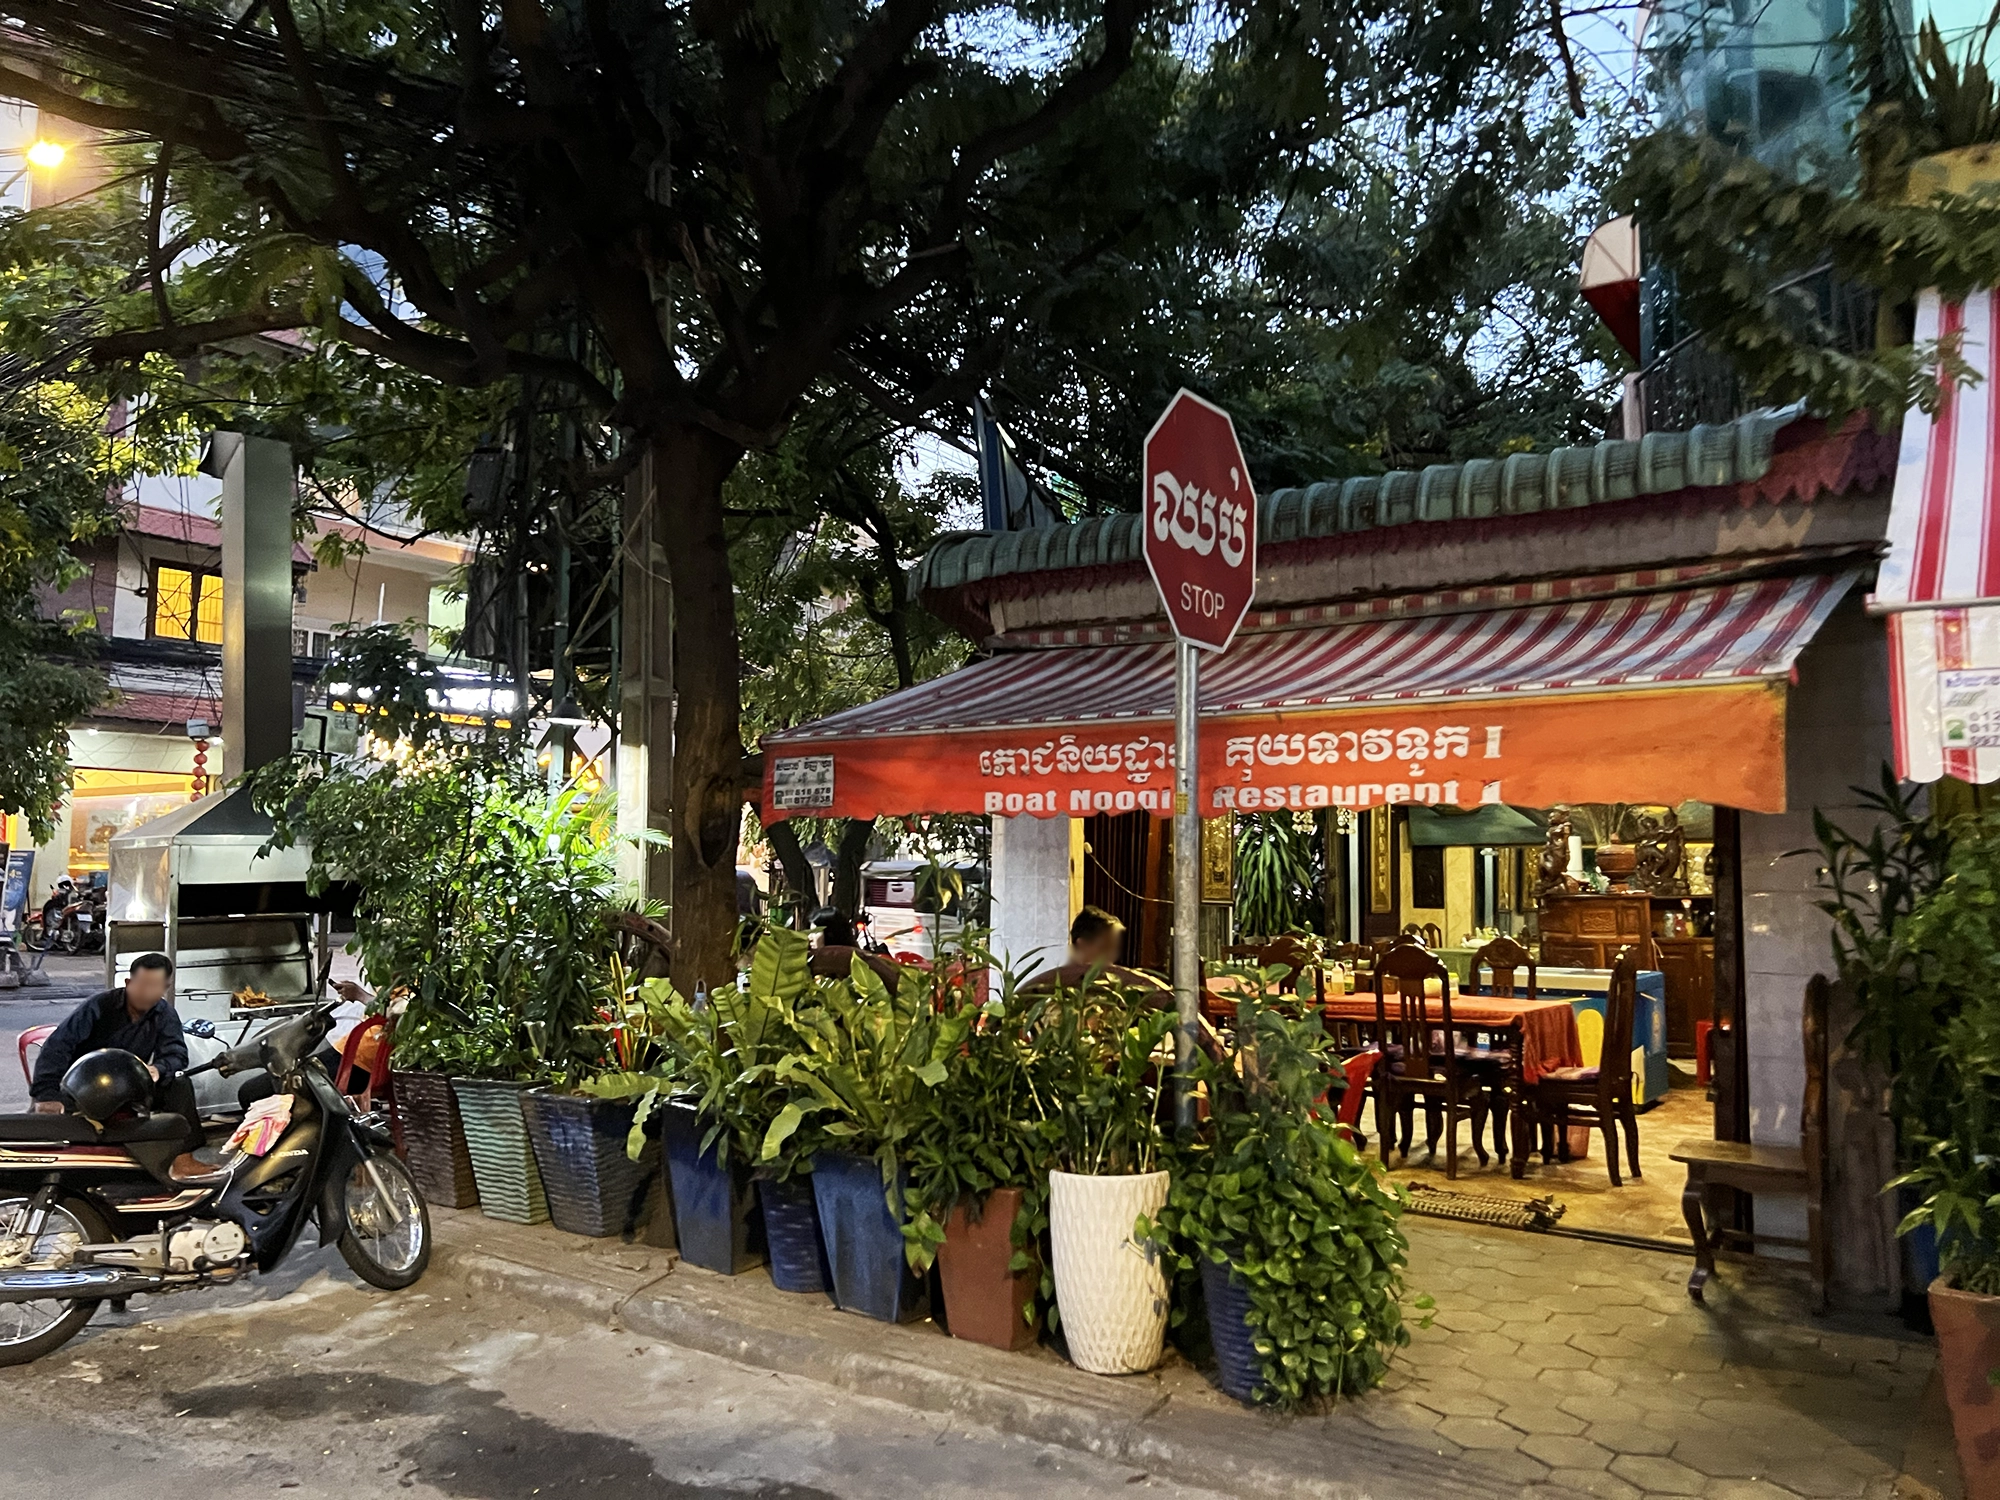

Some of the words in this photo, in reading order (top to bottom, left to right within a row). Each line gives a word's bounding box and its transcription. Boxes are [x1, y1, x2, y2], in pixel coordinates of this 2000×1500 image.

[1153, 466, 1248, 568] ឈប់
[1180, 581, 1225, 620] STOP
[984, 790, 1057, 812] Boat
[1069, 788, 1172, 811] Noodl
[1212, 779, 1460, 809] Restaurent
